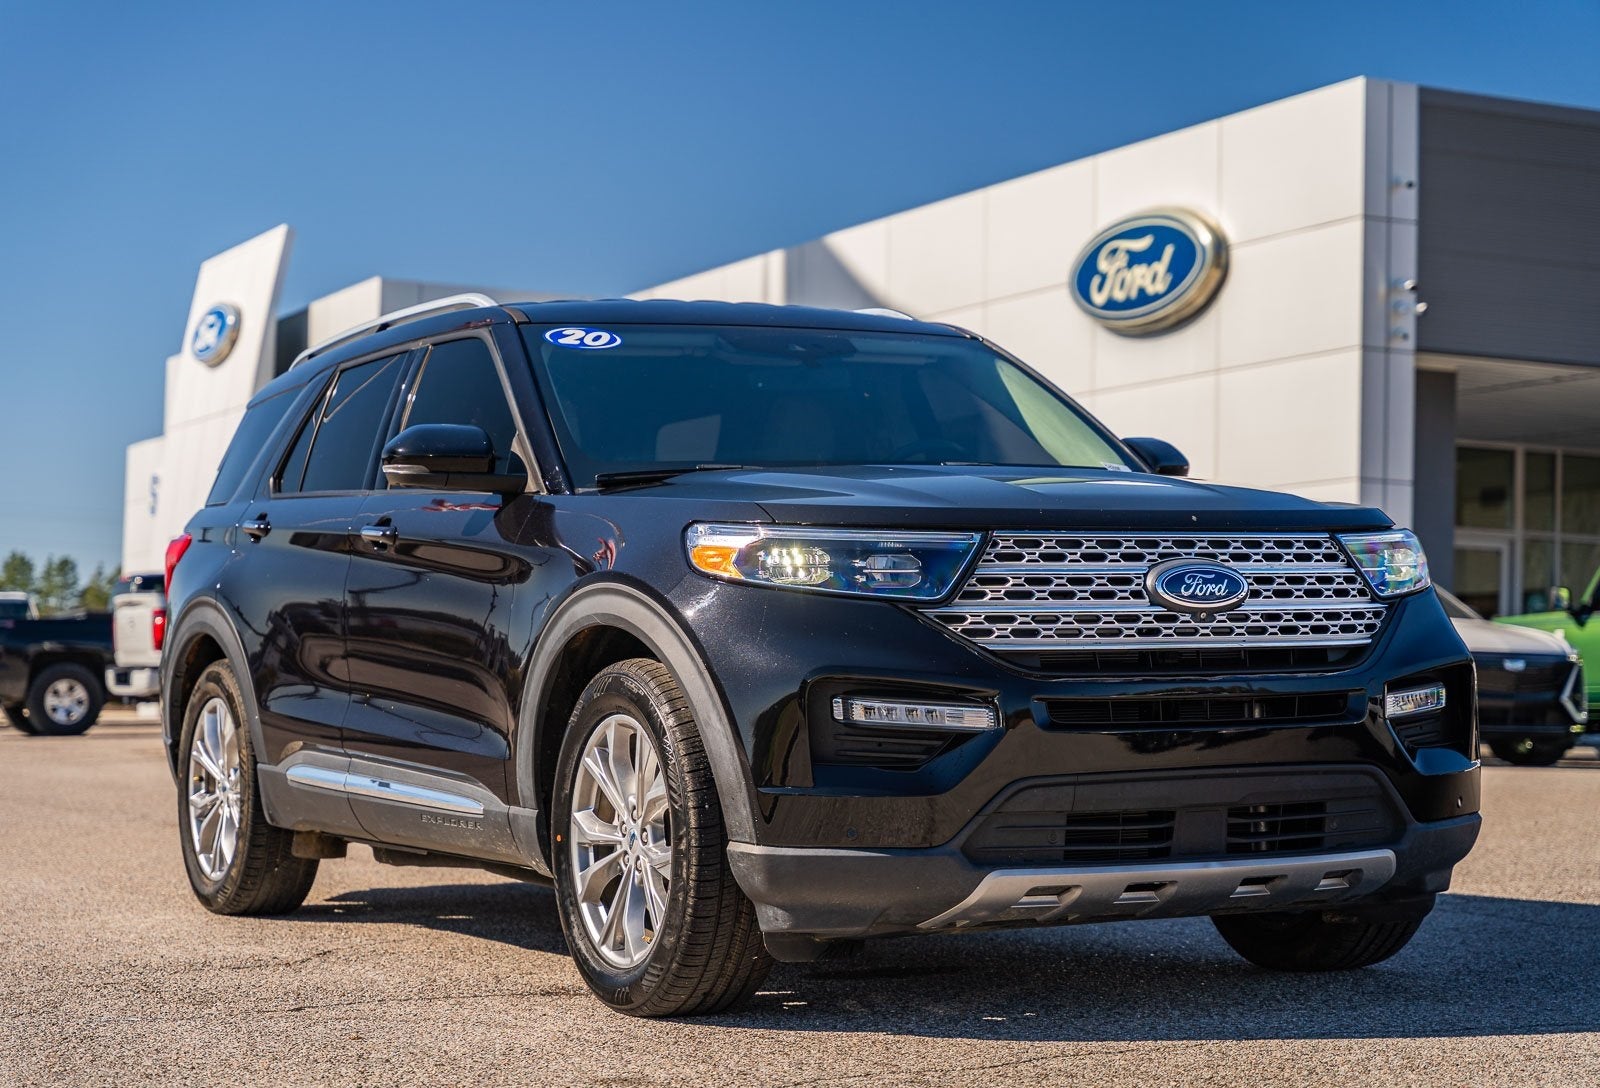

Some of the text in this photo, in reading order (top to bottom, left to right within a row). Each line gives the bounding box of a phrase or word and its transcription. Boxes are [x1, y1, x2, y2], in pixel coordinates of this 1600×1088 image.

[1089, 233, 1175, 308] Ford
[557, 329, 611, 346] 20
[1181, 573, 1229, 596] Ford
[421, 814, 484, 831] EXPLORER
